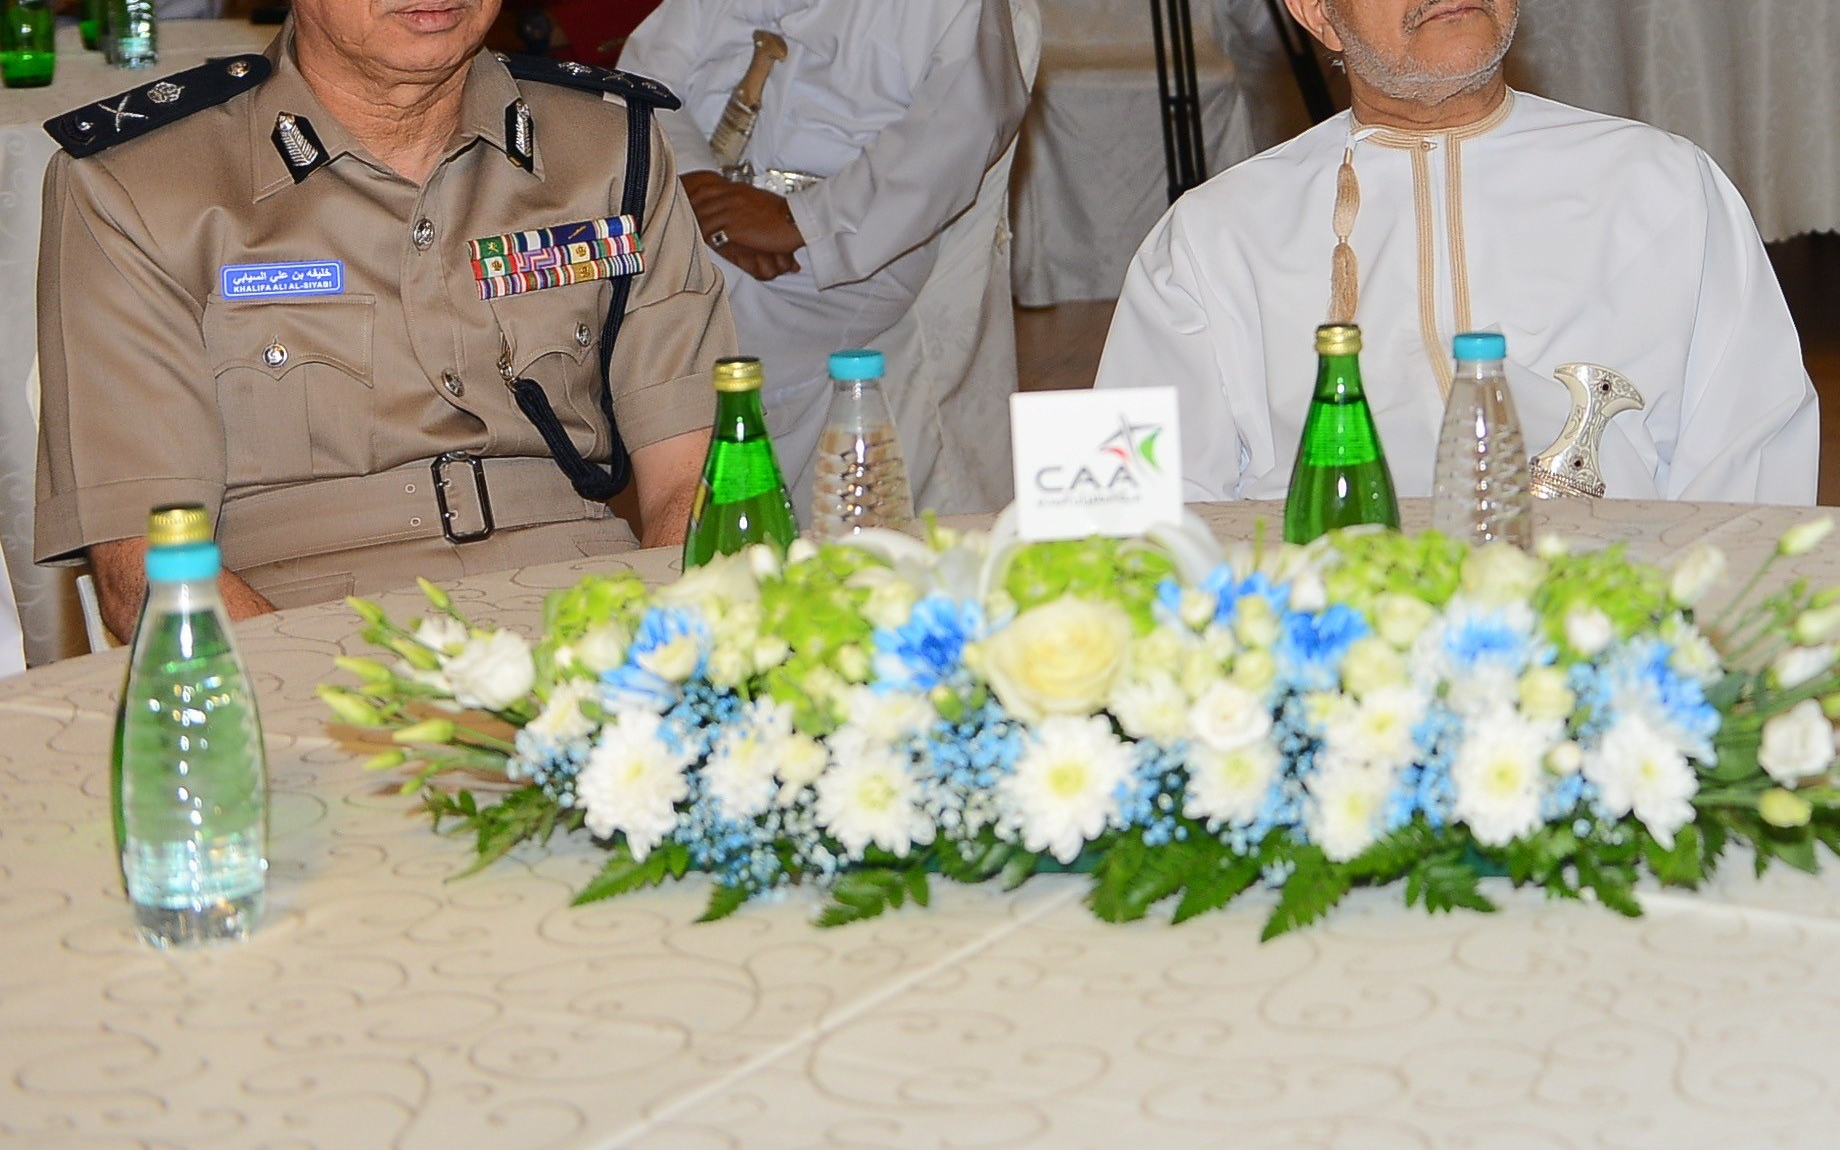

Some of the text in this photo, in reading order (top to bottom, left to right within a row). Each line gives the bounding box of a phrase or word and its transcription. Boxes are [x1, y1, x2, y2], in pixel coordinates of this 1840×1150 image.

[292, 271, 304, 281] بن
[233, 285, 271, 293] KHALIFA
[272, 283, 287, 291] ALI
[1036, 465, 1139, 492] CAA
